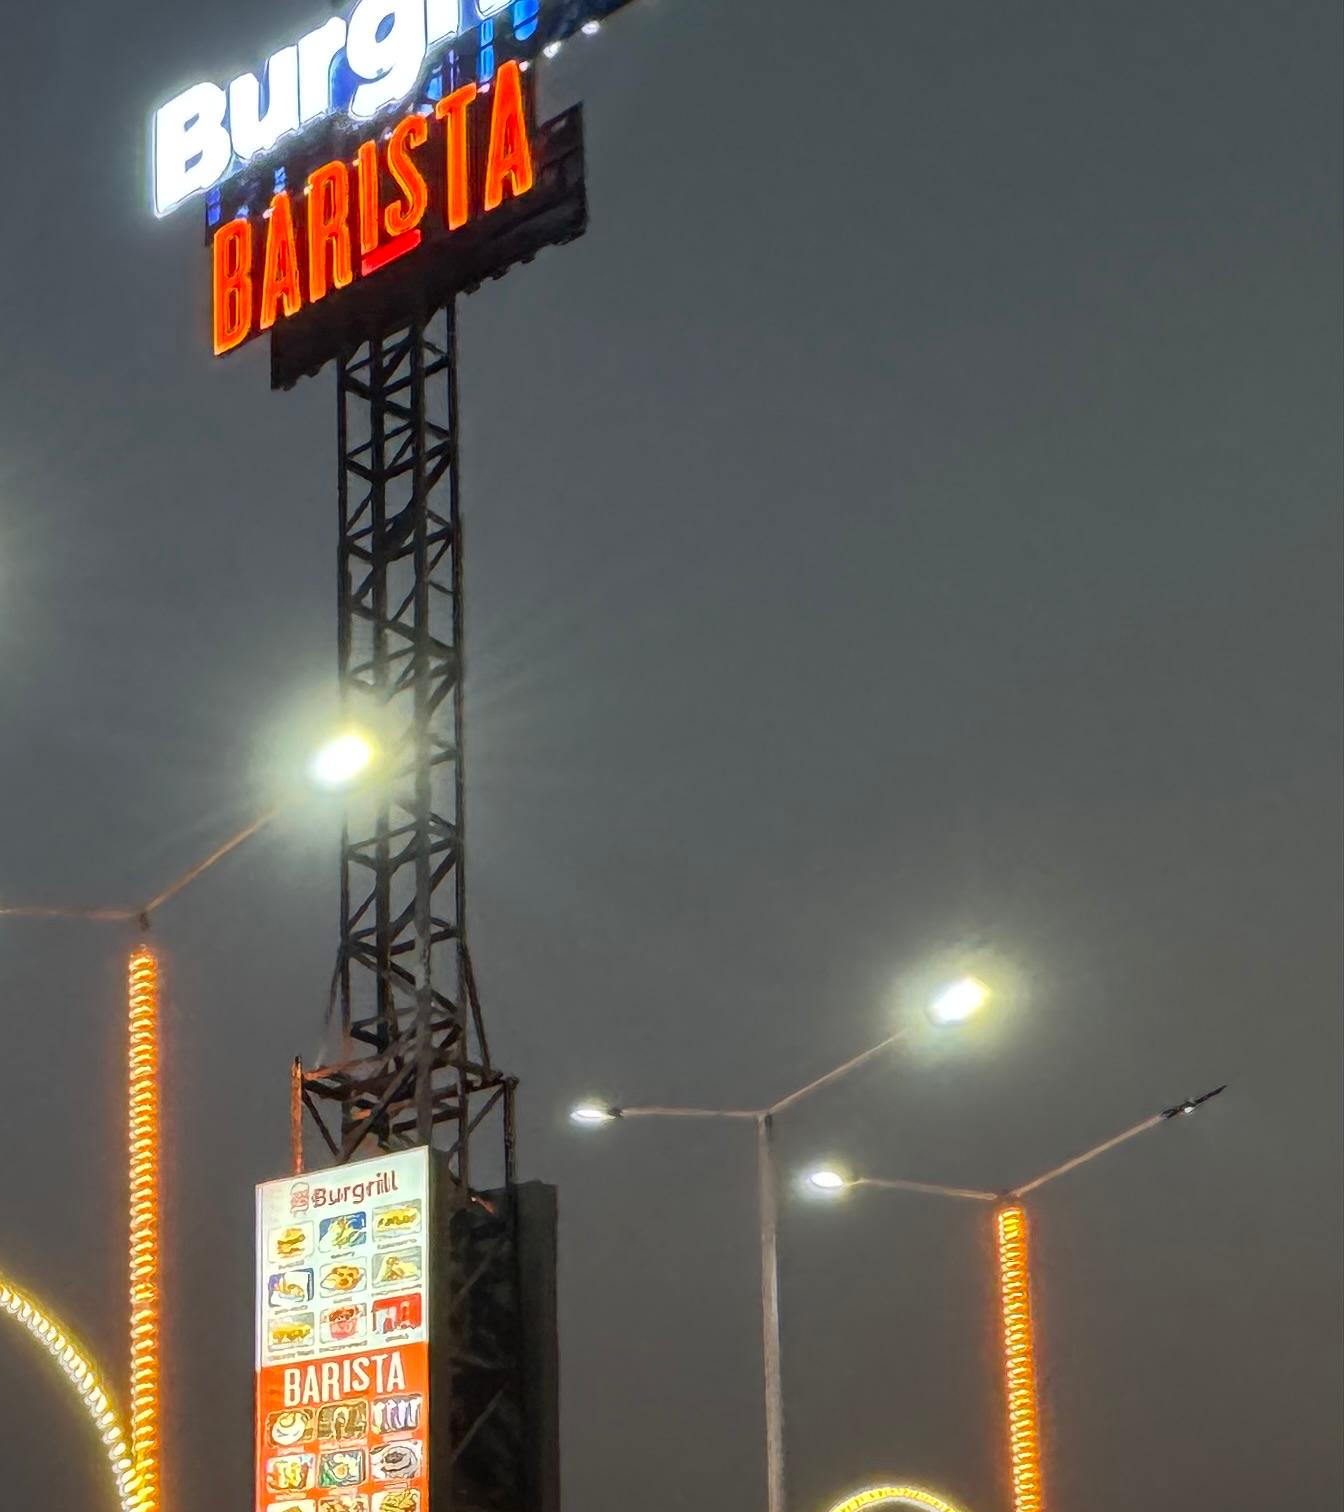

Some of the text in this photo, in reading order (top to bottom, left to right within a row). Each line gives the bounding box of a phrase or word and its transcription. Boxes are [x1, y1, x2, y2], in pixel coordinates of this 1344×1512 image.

[213, 58, 536, 357] BARISTA
[312, 1169, 399, 1209] Burgrill
[283, 1352, 406, 1408] BARISTA
